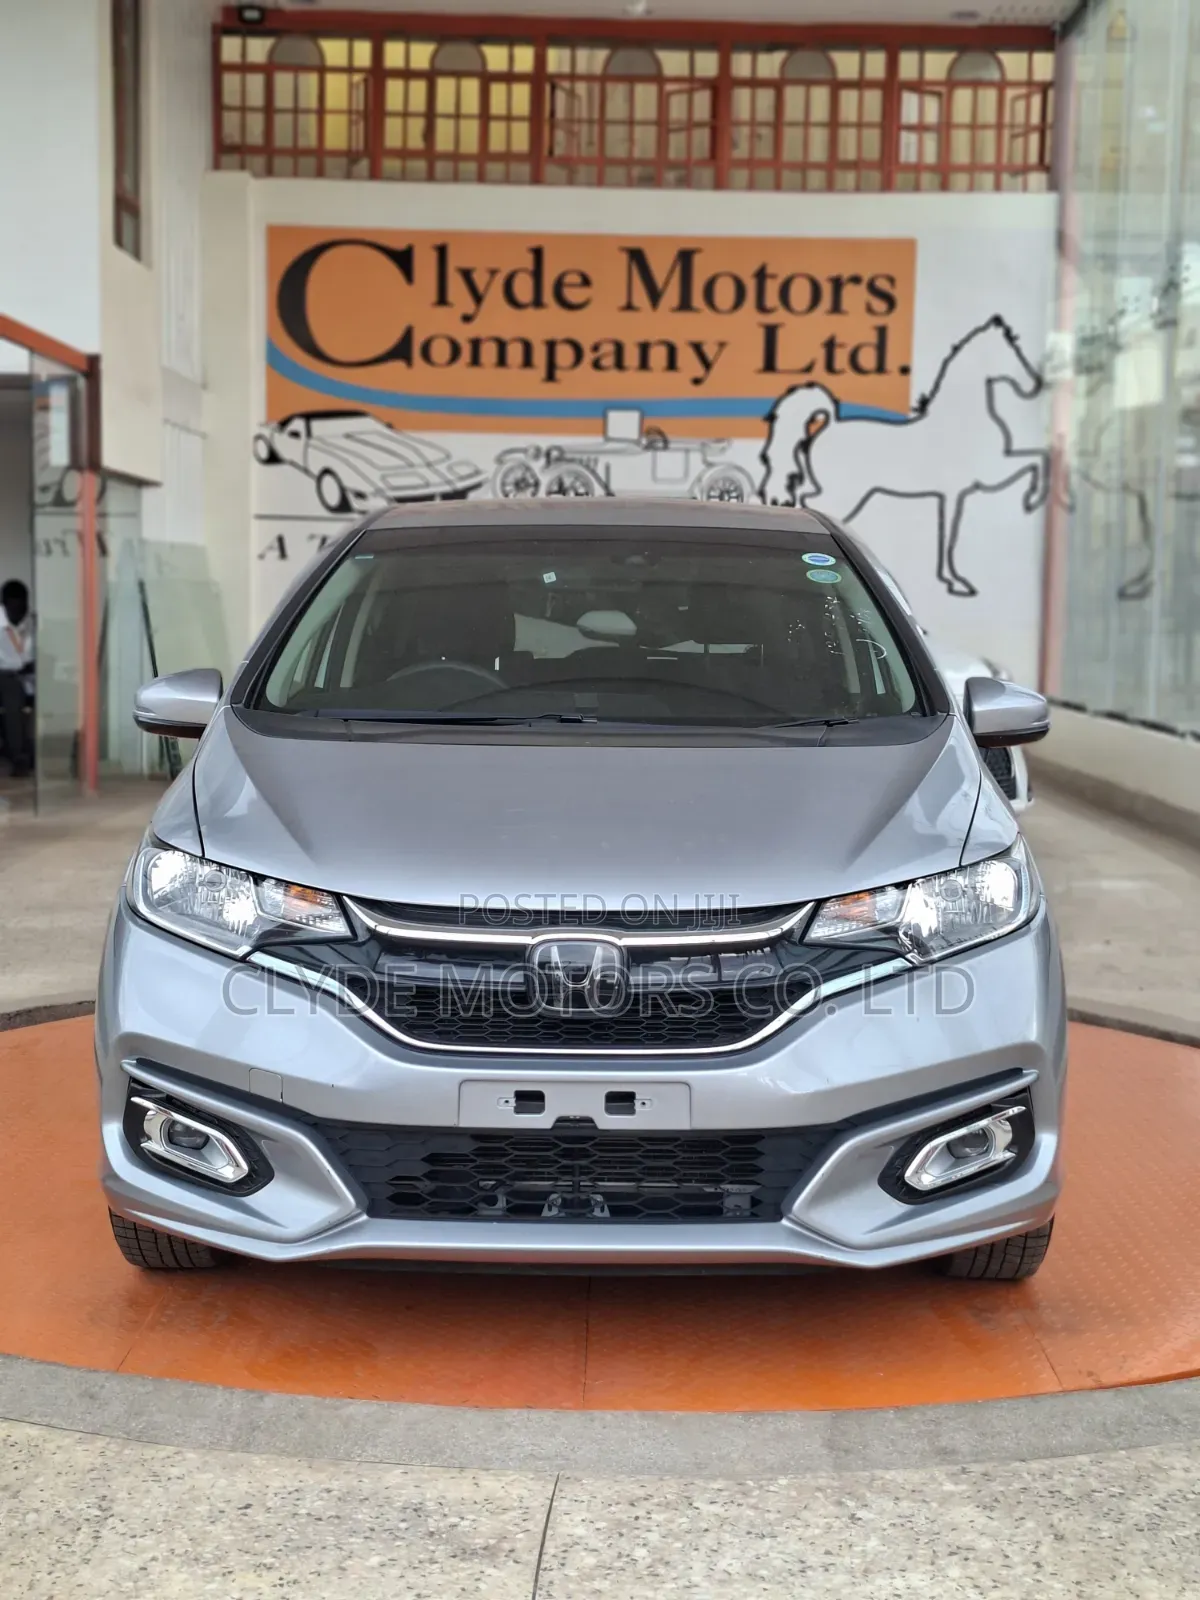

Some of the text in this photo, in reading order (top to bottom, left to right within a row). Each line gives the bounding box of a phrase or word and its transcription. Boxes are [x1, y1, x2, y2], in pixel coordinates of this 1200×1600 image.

[276, 238, 898, 370] Clyde Motors
[754, 322, 911, 376] Ltd.
